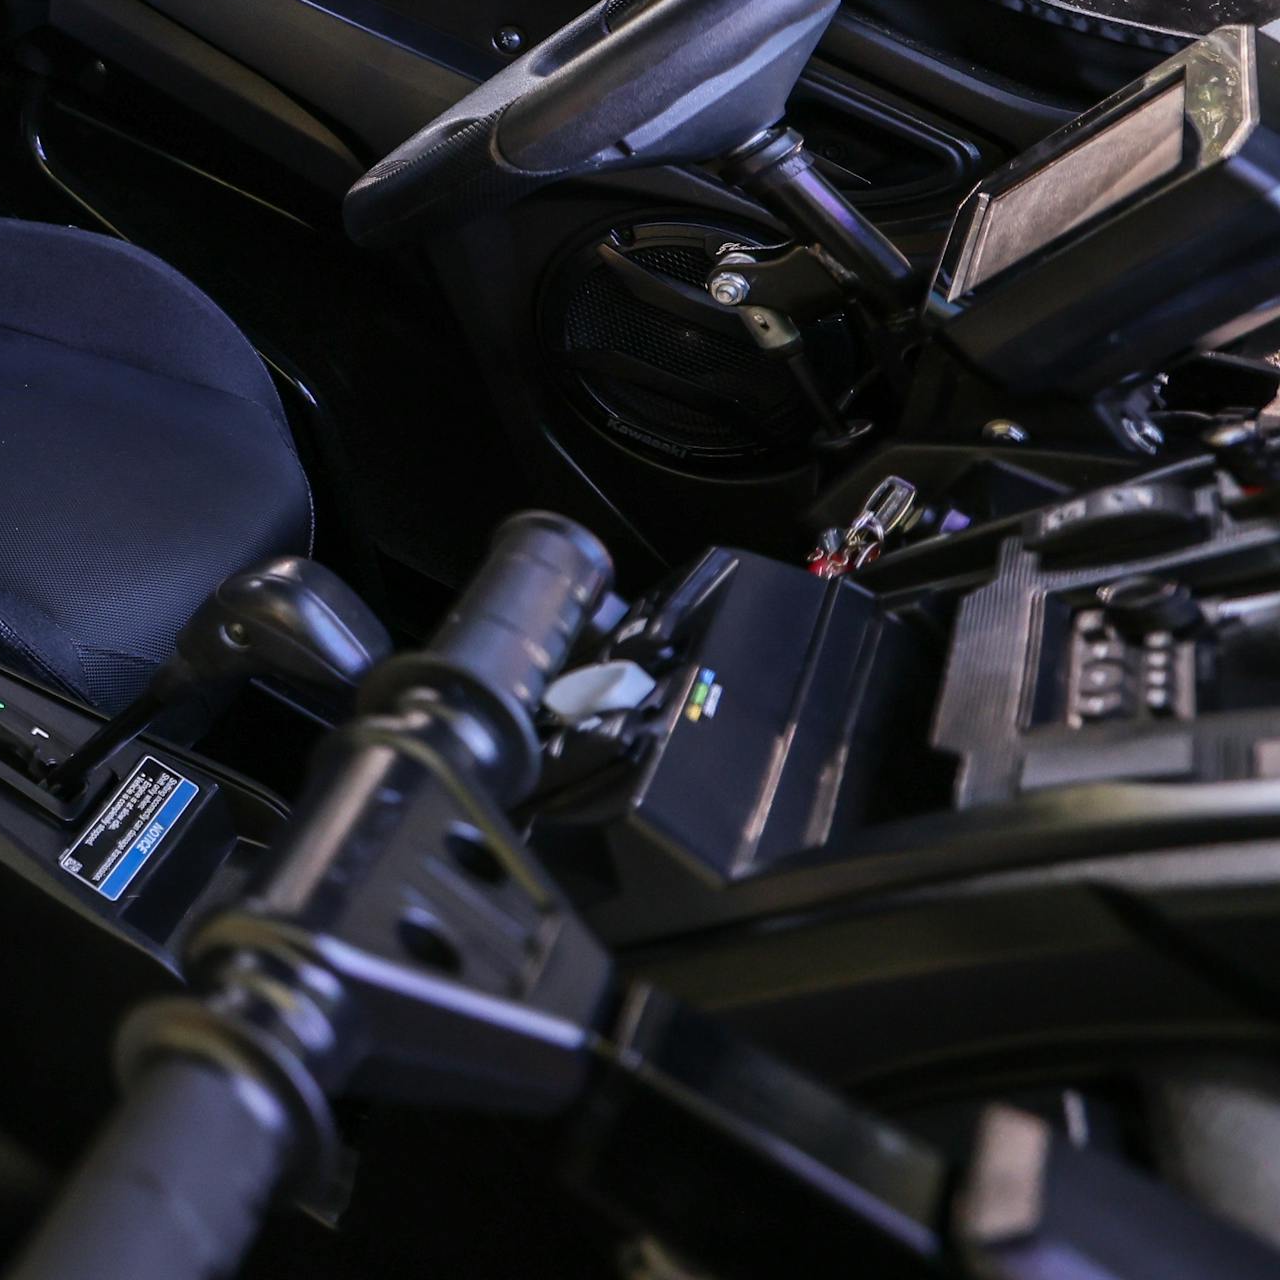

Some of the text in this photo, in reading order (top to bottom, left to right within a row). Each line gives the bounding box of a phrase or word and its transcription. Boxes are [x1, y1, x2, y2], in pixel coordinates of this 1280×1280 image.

[156, 772, 170, 786] Shift
[147, 783, 161, 796] only
[136, 822, 163, 854] NOTICE
